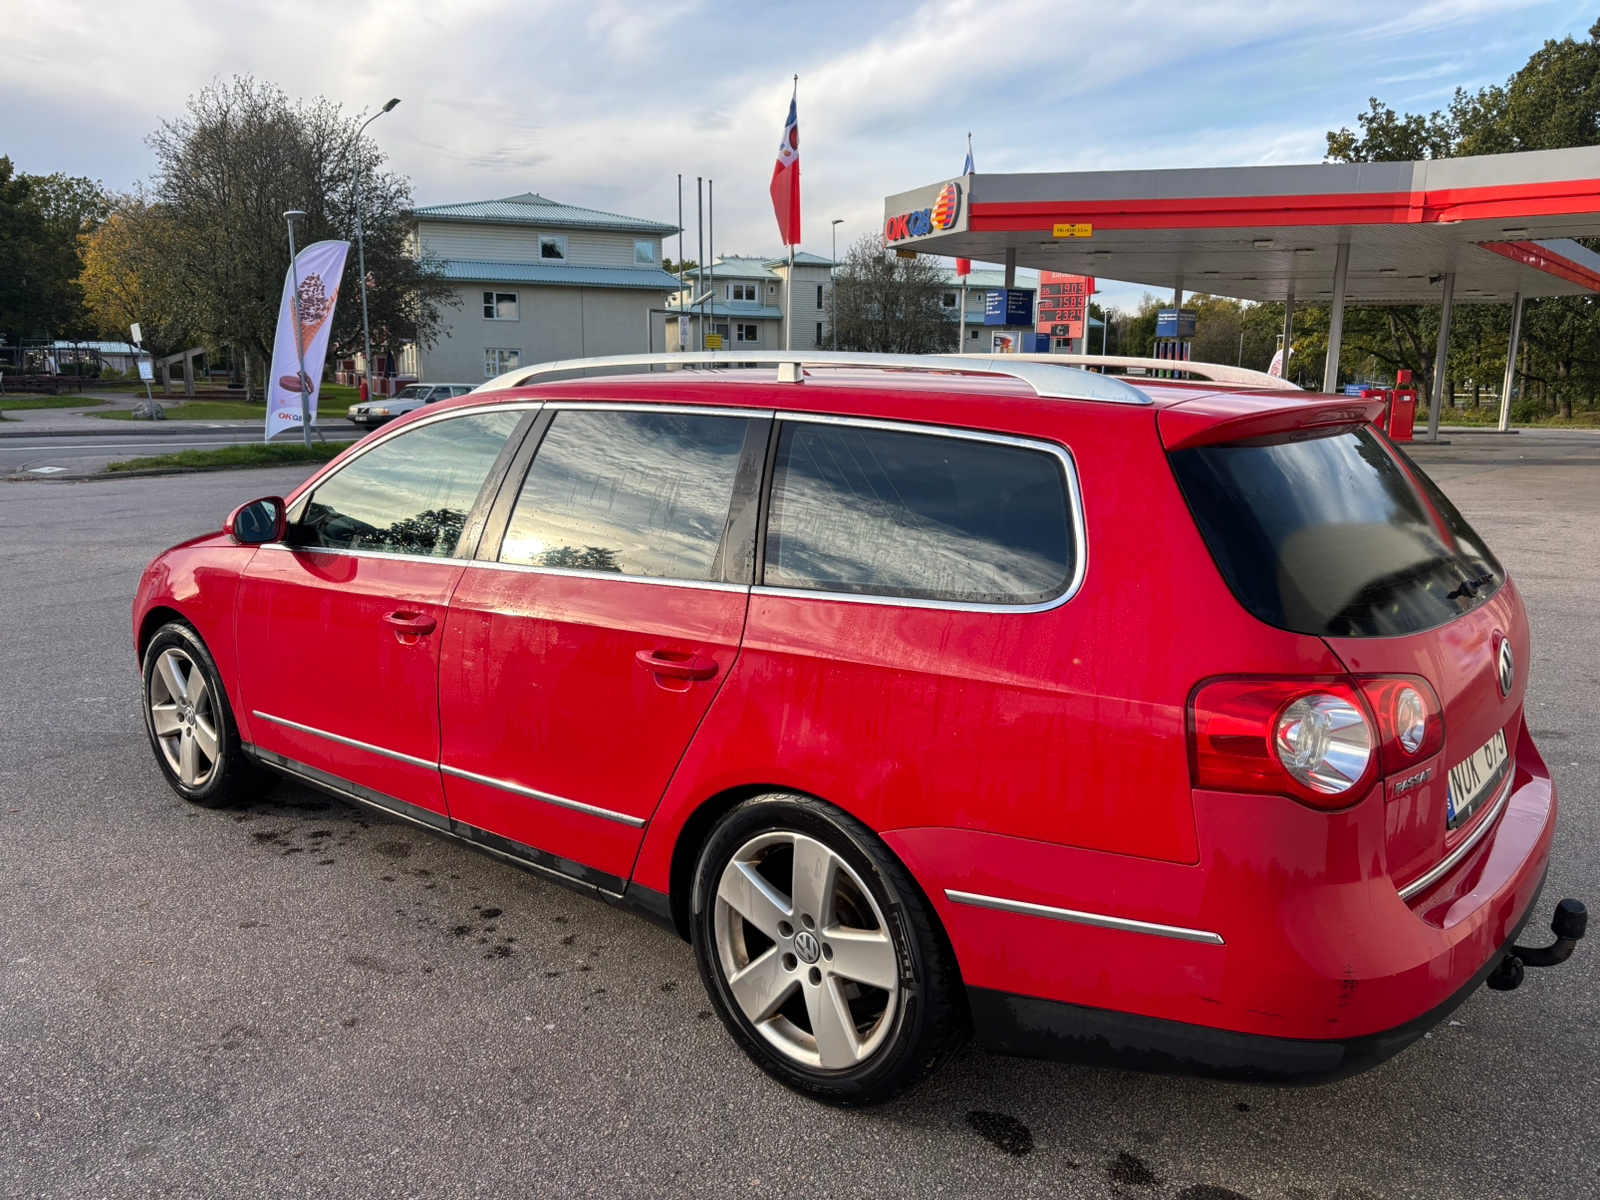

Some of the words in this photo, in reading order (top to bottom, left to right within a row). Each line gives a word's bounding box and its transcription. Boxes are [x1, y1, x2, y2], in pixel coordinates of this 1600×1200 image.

[886, 208, 930, 241] OKQ8
[1060, 284, 1083, 294] 19.09
[1060, 297, 1083, 307] 15.89
[1056, 310, 1082, 321] 23.24
[278, 412, 303, 423] OKQ8
[1395, 768, 1432, 795] PASSAT
